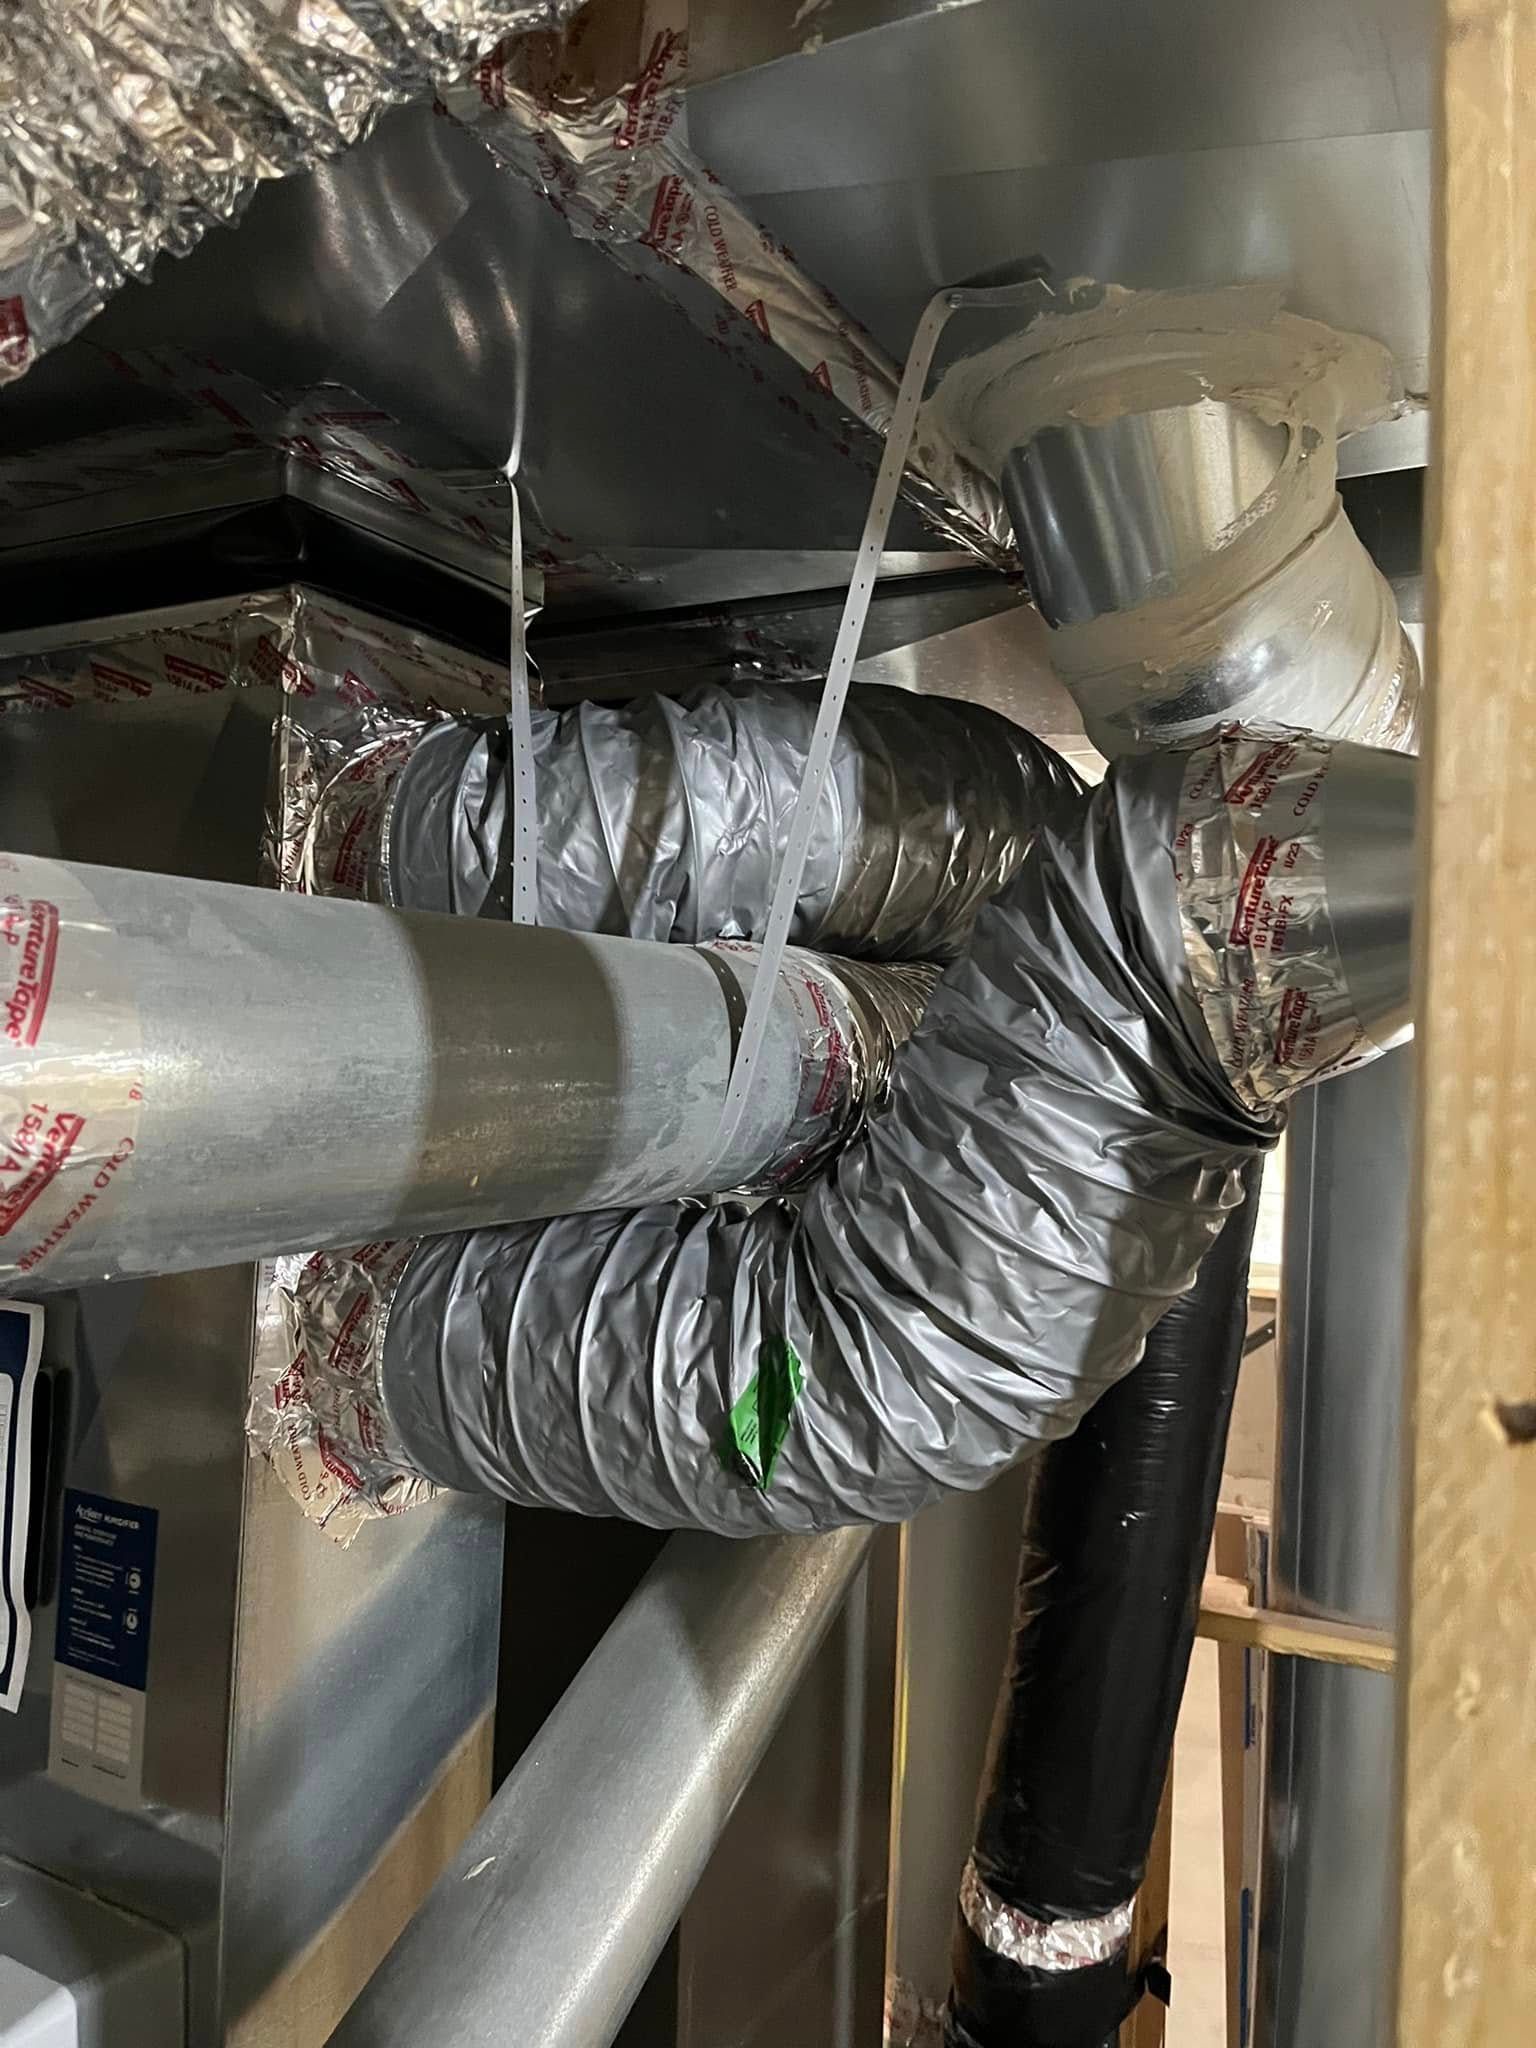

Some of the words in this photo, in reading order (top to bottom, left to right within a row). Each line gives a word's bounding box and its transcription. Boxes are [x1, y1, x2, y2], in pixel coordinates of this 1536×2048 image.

[704, 205, 722, 238] COLD
[1229, 745, 1286, 804] VentureTa
[1293, 781, 1319, 817] COLD
[1238, 837, 1280, 945] VentureTape
[1253, 900, 1275, 951] 181A-P
[94, 1136, 135, 1188] COLD
[16, 1193, 99, 1272] WEATHER
